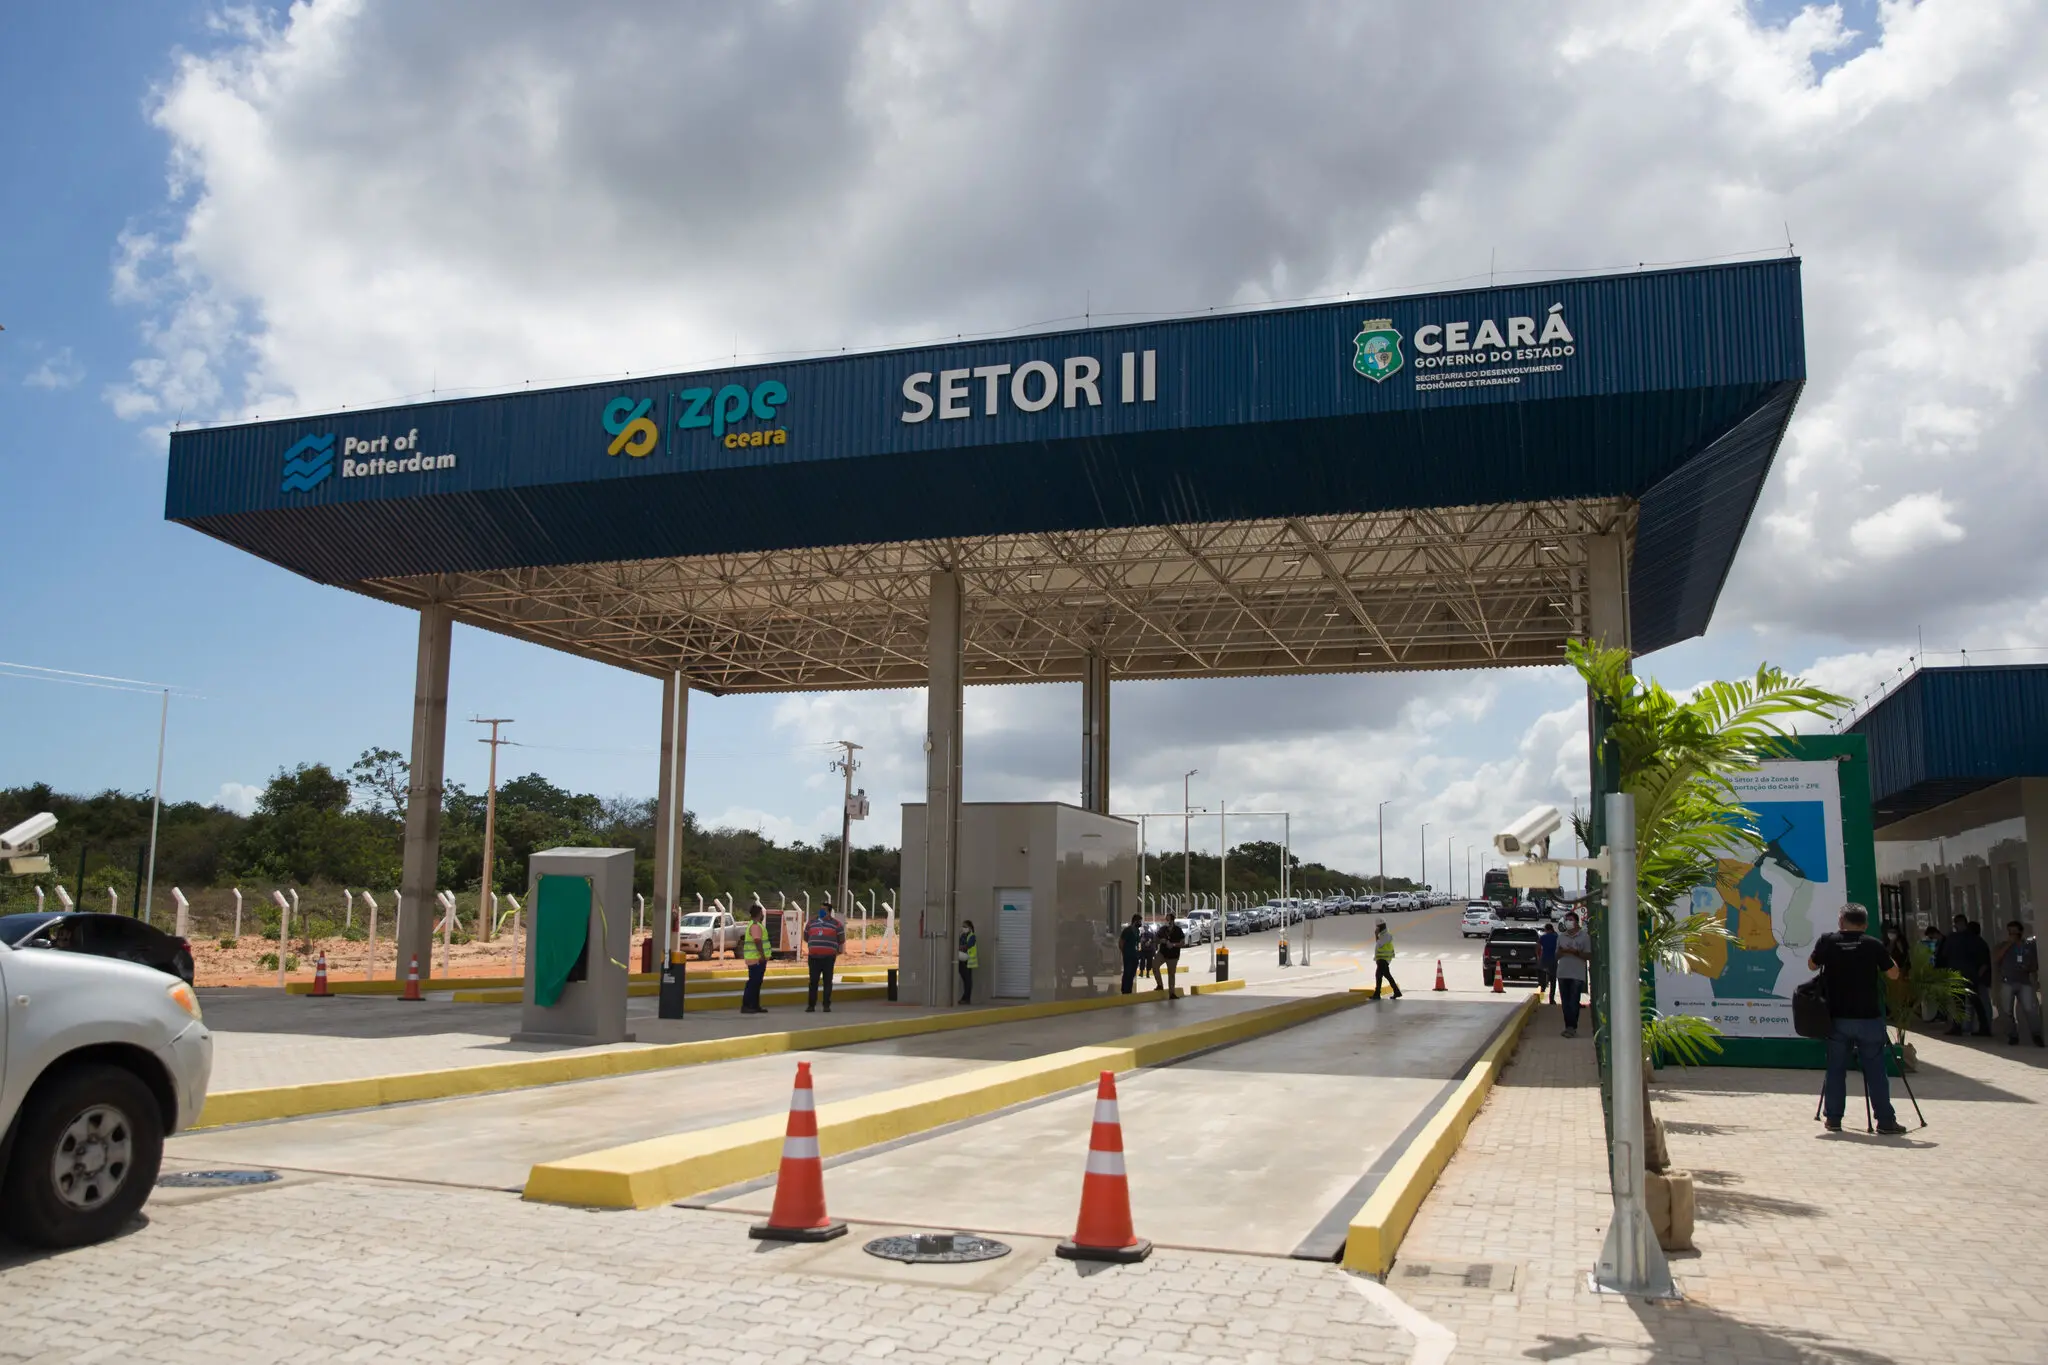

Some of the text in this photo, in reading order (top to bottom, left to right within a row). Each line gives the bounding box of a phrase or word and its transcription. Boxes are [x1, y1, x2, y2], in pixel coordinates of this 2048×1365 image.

[1414, 302, 1574, 354] CEARÁ
[1414, 345, 1575, 369] GOVERNO DO ESTADO
[901, 349, 1156, 423] SETOR II
[1415, 364, 1563, 382] SECRETARIA DO DESENVOLVIMENTO
[1415, 380, 1467, 391] ECONÔMICO
[1475, 376, 1521, 386] TRABALHO
[678, 380, 788, 437] zpe
[344, 428, 418, 456] Port of
[342, 451, 457, 478] Rotterdam
